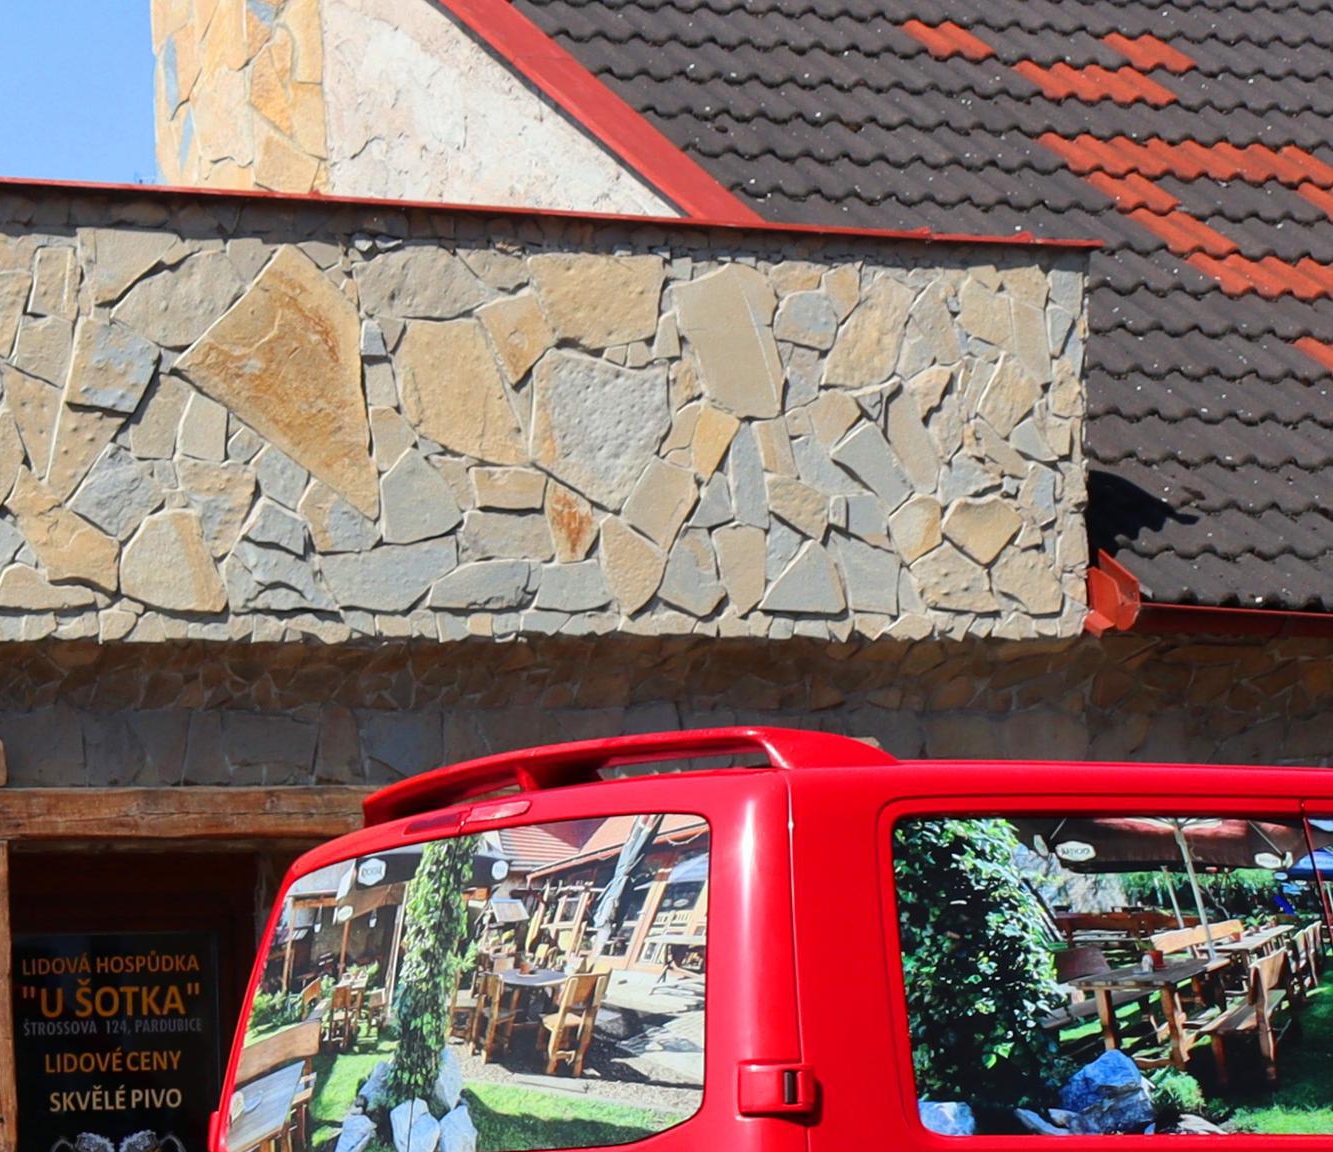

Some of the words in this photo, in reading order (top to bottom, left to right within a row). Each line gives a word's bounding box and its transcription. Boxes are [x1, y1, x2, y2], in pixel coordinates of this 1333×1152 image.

[22, 953, 91, 976] LIDOVÁ
[96, 951, 200, 974] HOSPŮDKA
[75, 978, 200, 1017] ŠOTKA"
[135, 1018, 203, 1033] PARDUBICE
[44, 1047, 122, 1073] LIDOVÉ
[126, 1050, 182, 1071] CENY
[49, 1085, 126, 1112] SKVĚLÉ
[131, 1088, 182, 1109] PIVO
